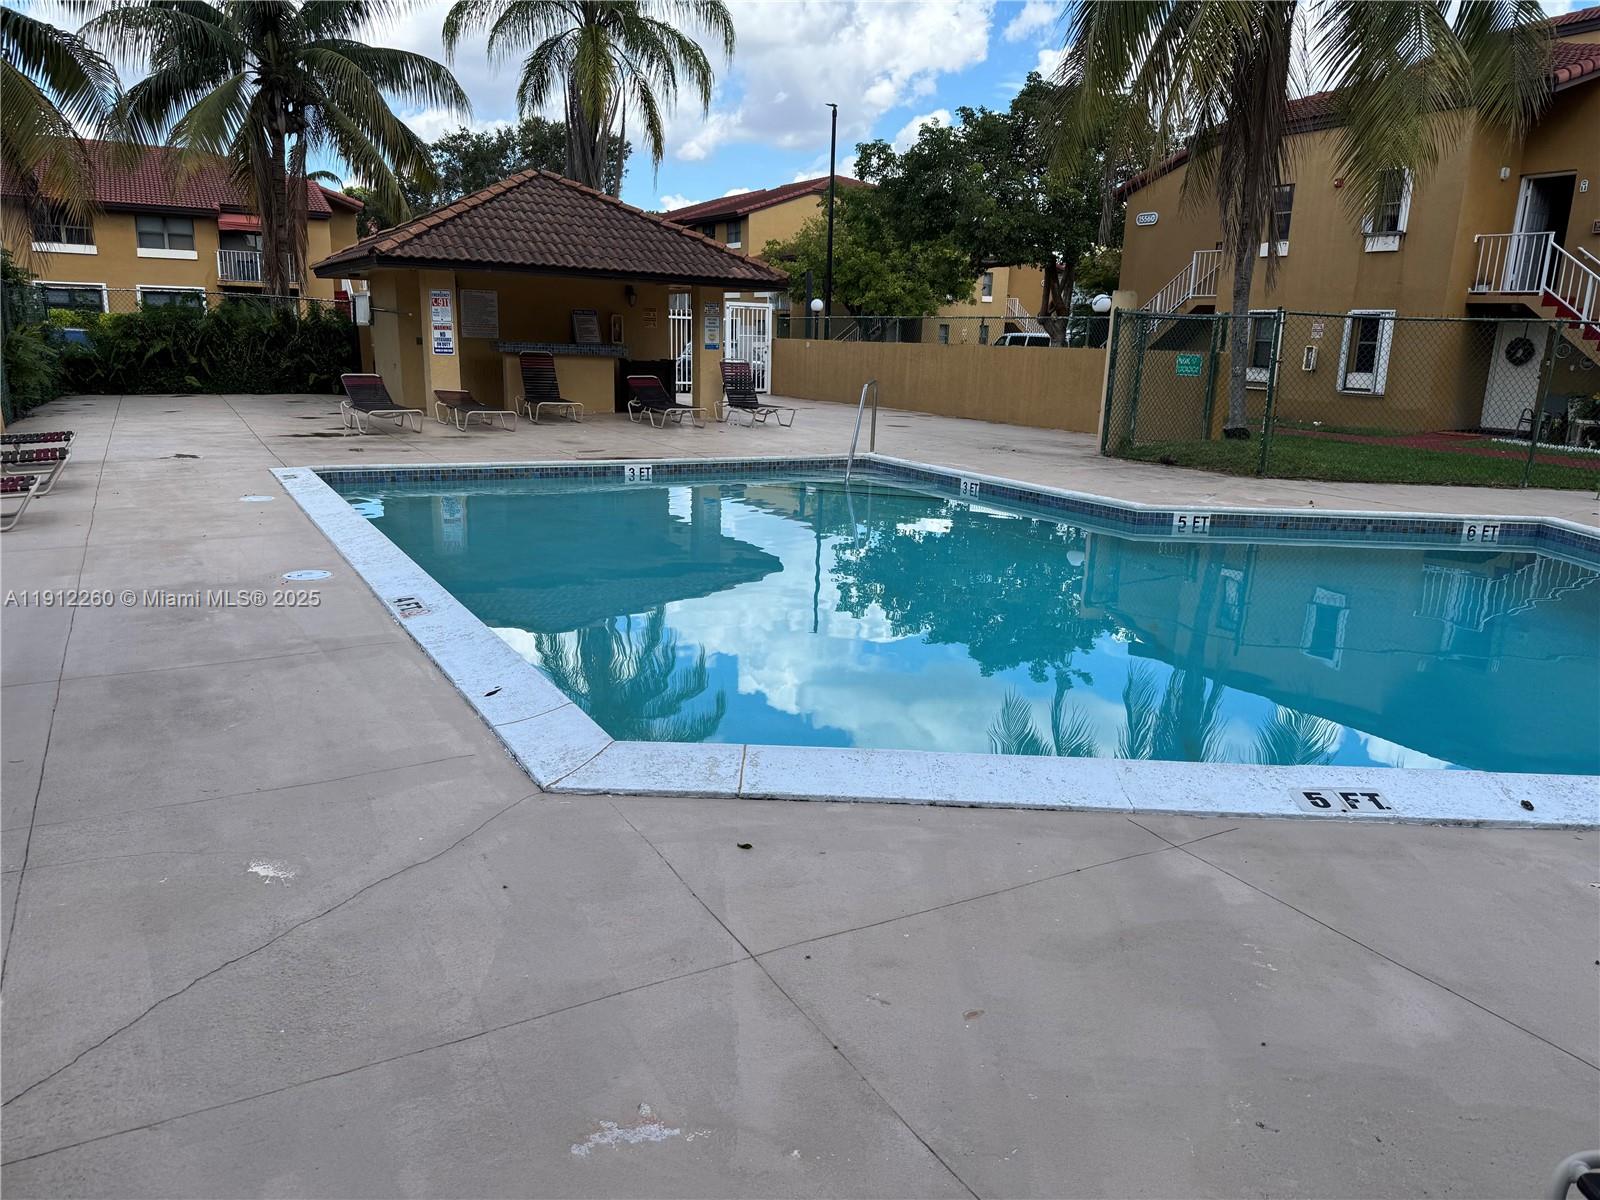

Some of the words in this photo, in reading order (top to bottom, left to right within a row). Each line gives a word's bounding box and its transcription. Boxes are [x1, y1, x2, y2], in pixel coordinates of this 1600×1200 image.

[439, 298, 449, 307] 911
[629, 467, 635, 481] 3
[963, 481, 968, 494] 3
[1178, 516, 1187, 533] 5
[1467, 525, 1477, 541] 6
[1302, 792, 1331, 808] 5
